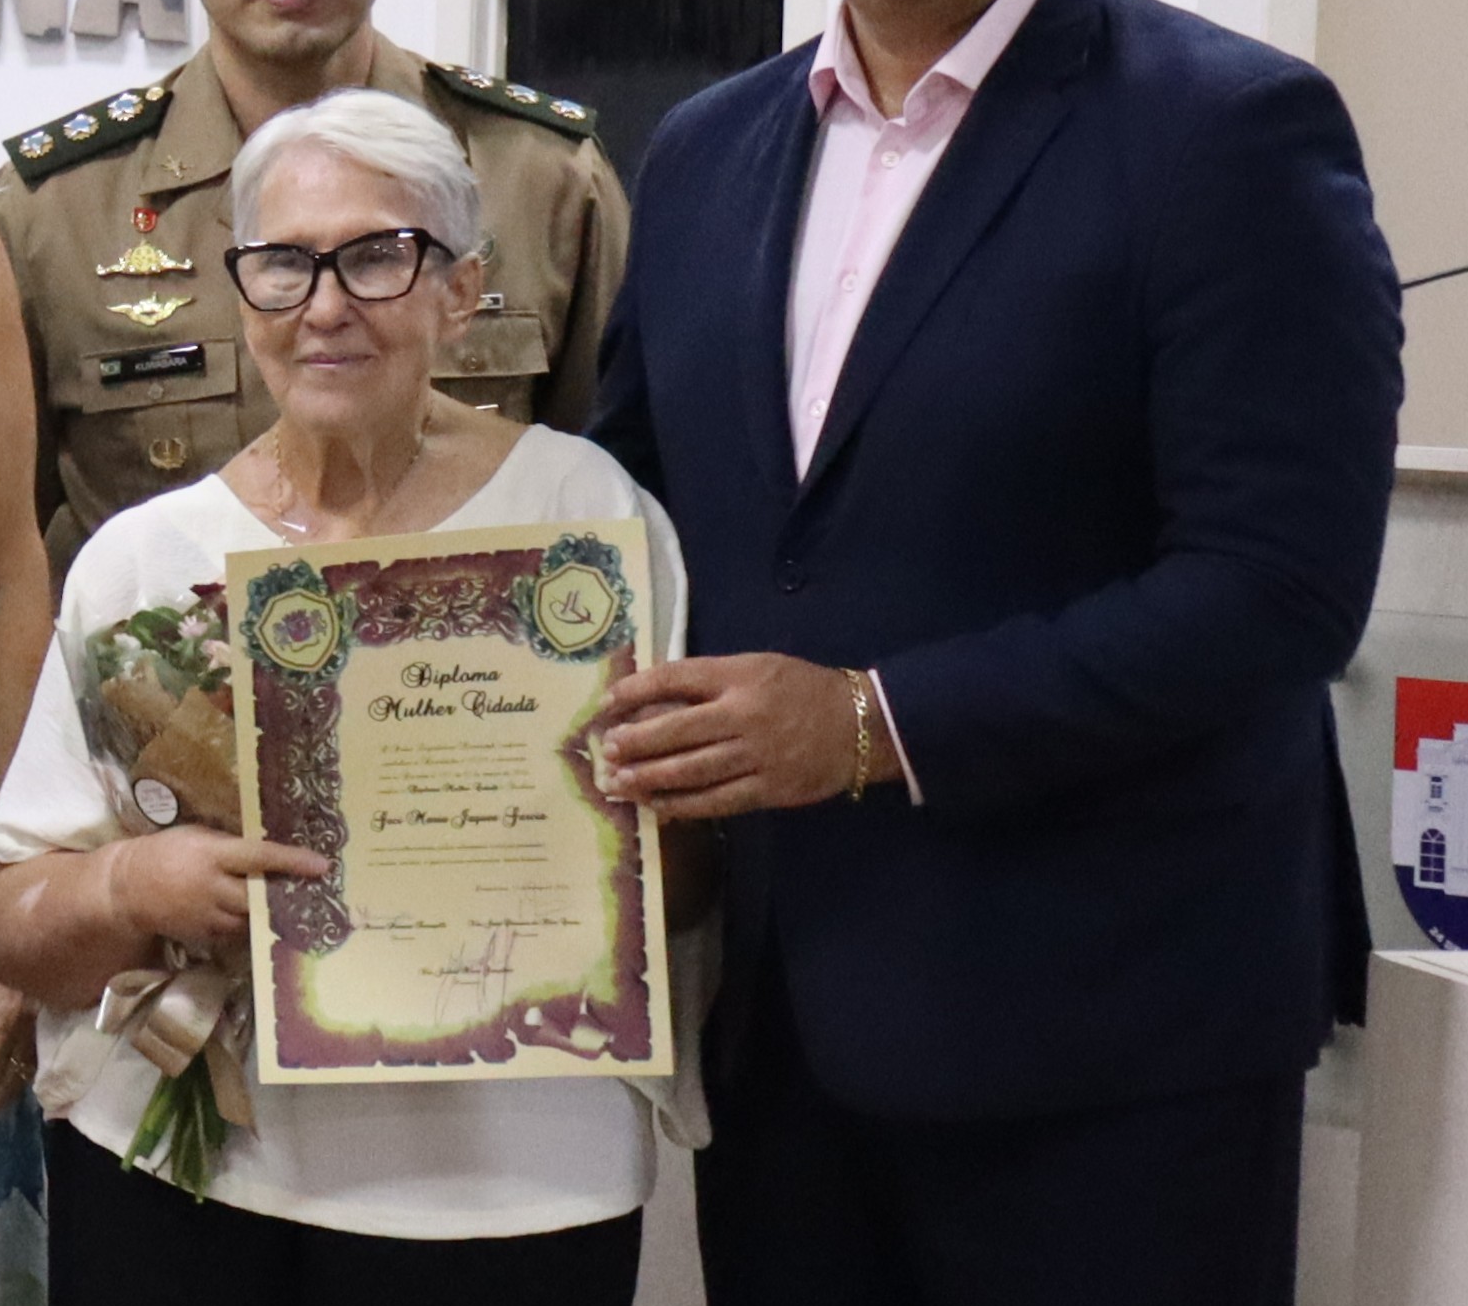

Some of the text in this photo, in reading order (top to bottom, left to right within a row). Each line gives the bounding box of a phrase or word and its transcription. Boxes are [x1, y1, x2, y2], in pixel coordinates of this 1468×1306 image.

[401, 660, 503, 690] Diploma
[368, 689, 540, 721] Mulher Cidadã
